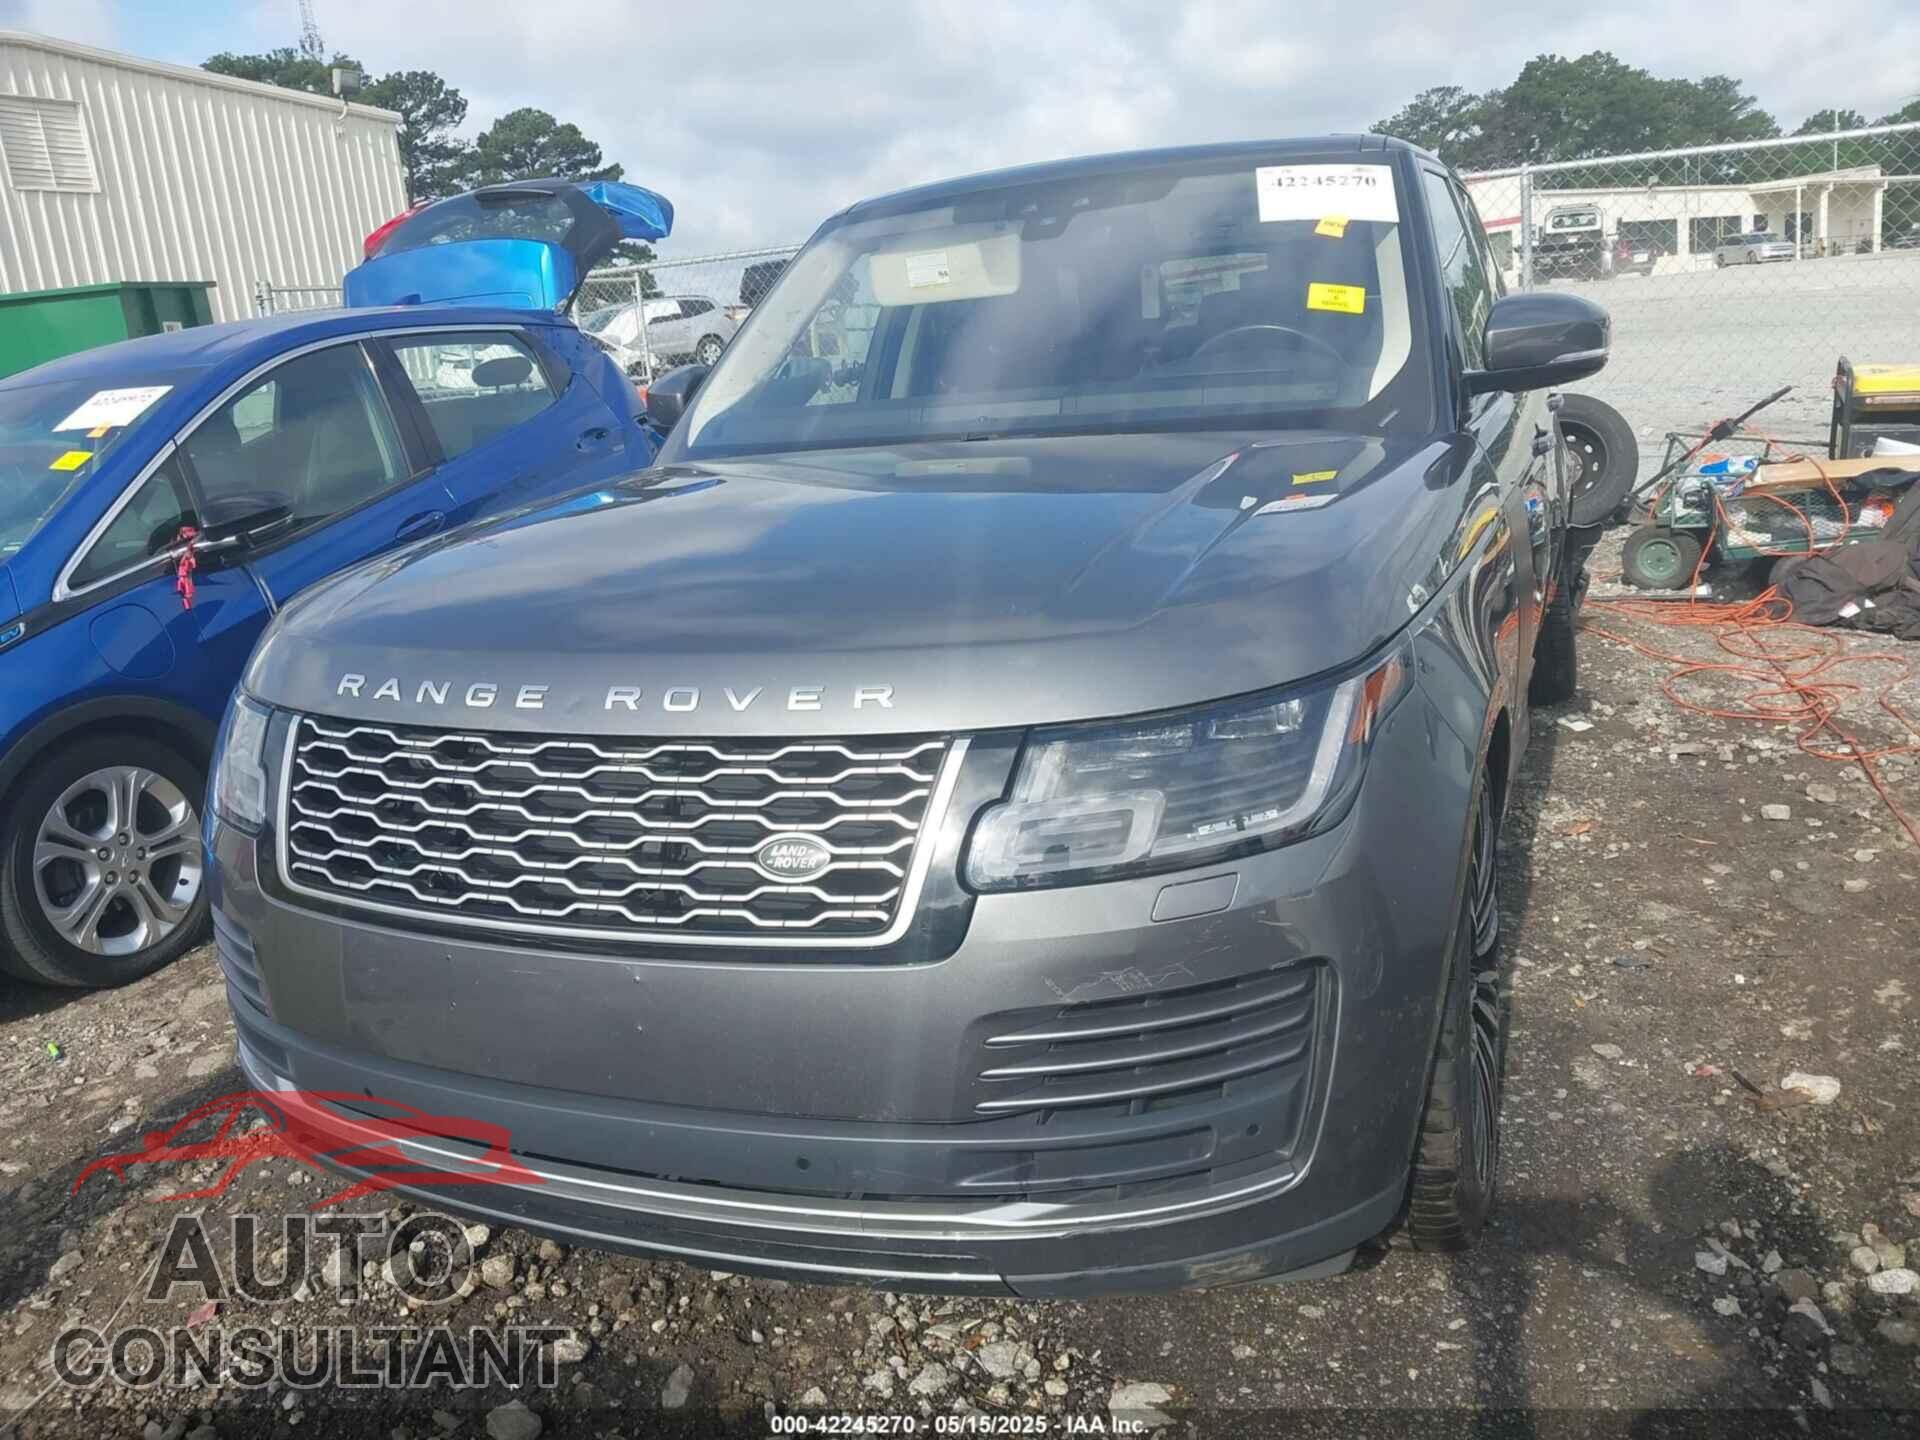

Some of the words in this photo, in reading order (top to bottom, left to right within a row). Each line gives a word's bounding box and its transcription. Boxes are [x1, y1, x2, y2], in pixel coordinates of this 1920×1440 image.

[336, 673, 549, 709] RANGE
[604, 685, 895, 712] ROVER
[770, 845, 807, 857] LAND
[773, 857, 817, 869] ROVER
